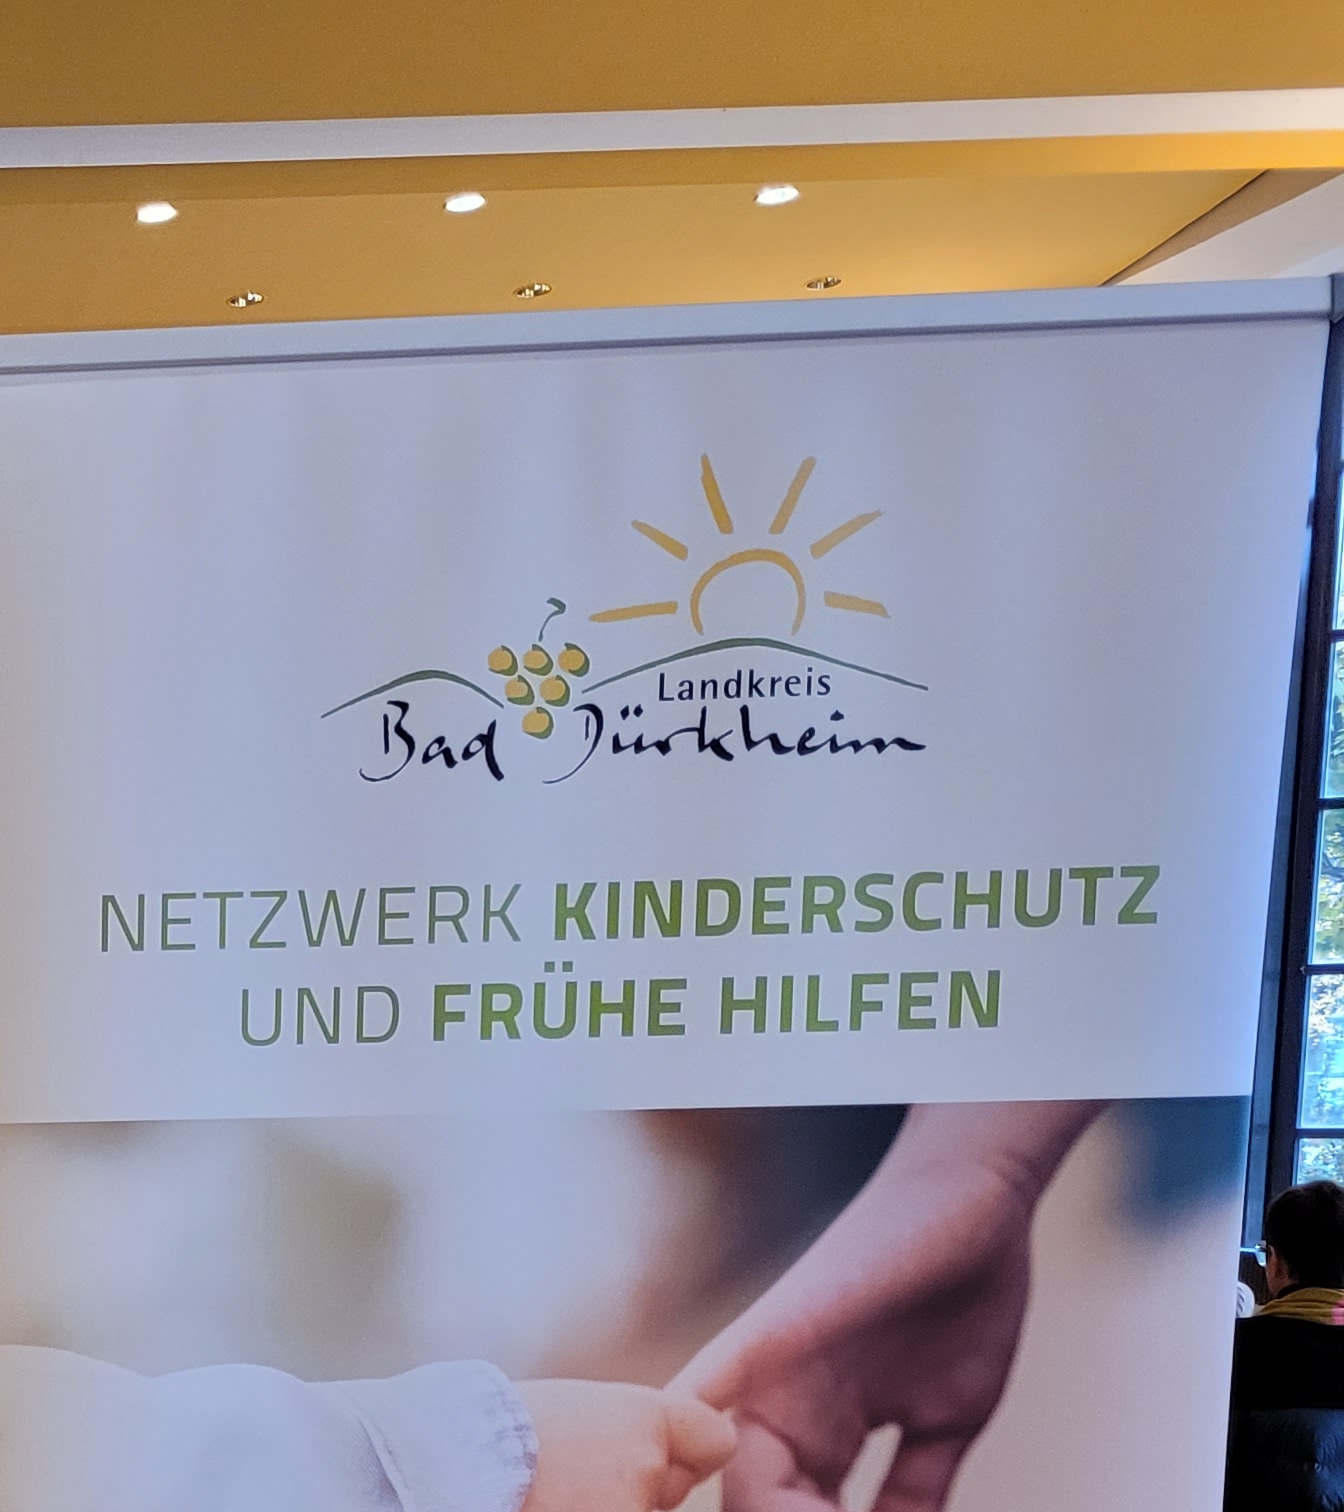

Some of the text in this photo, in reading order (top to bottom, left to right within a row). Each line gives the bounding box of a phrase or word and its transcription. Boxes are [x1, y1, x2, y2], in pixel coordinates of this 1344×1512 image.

[659, 667, 830, 701] Landkreis
[358, 700, 925, 784] Bad Dürkheim
[102, 865, 1160, 952] NETZWERK KINDERSCHUTZ
[242, 961, 1000, 1046] UND FRÜHE HILFEN
